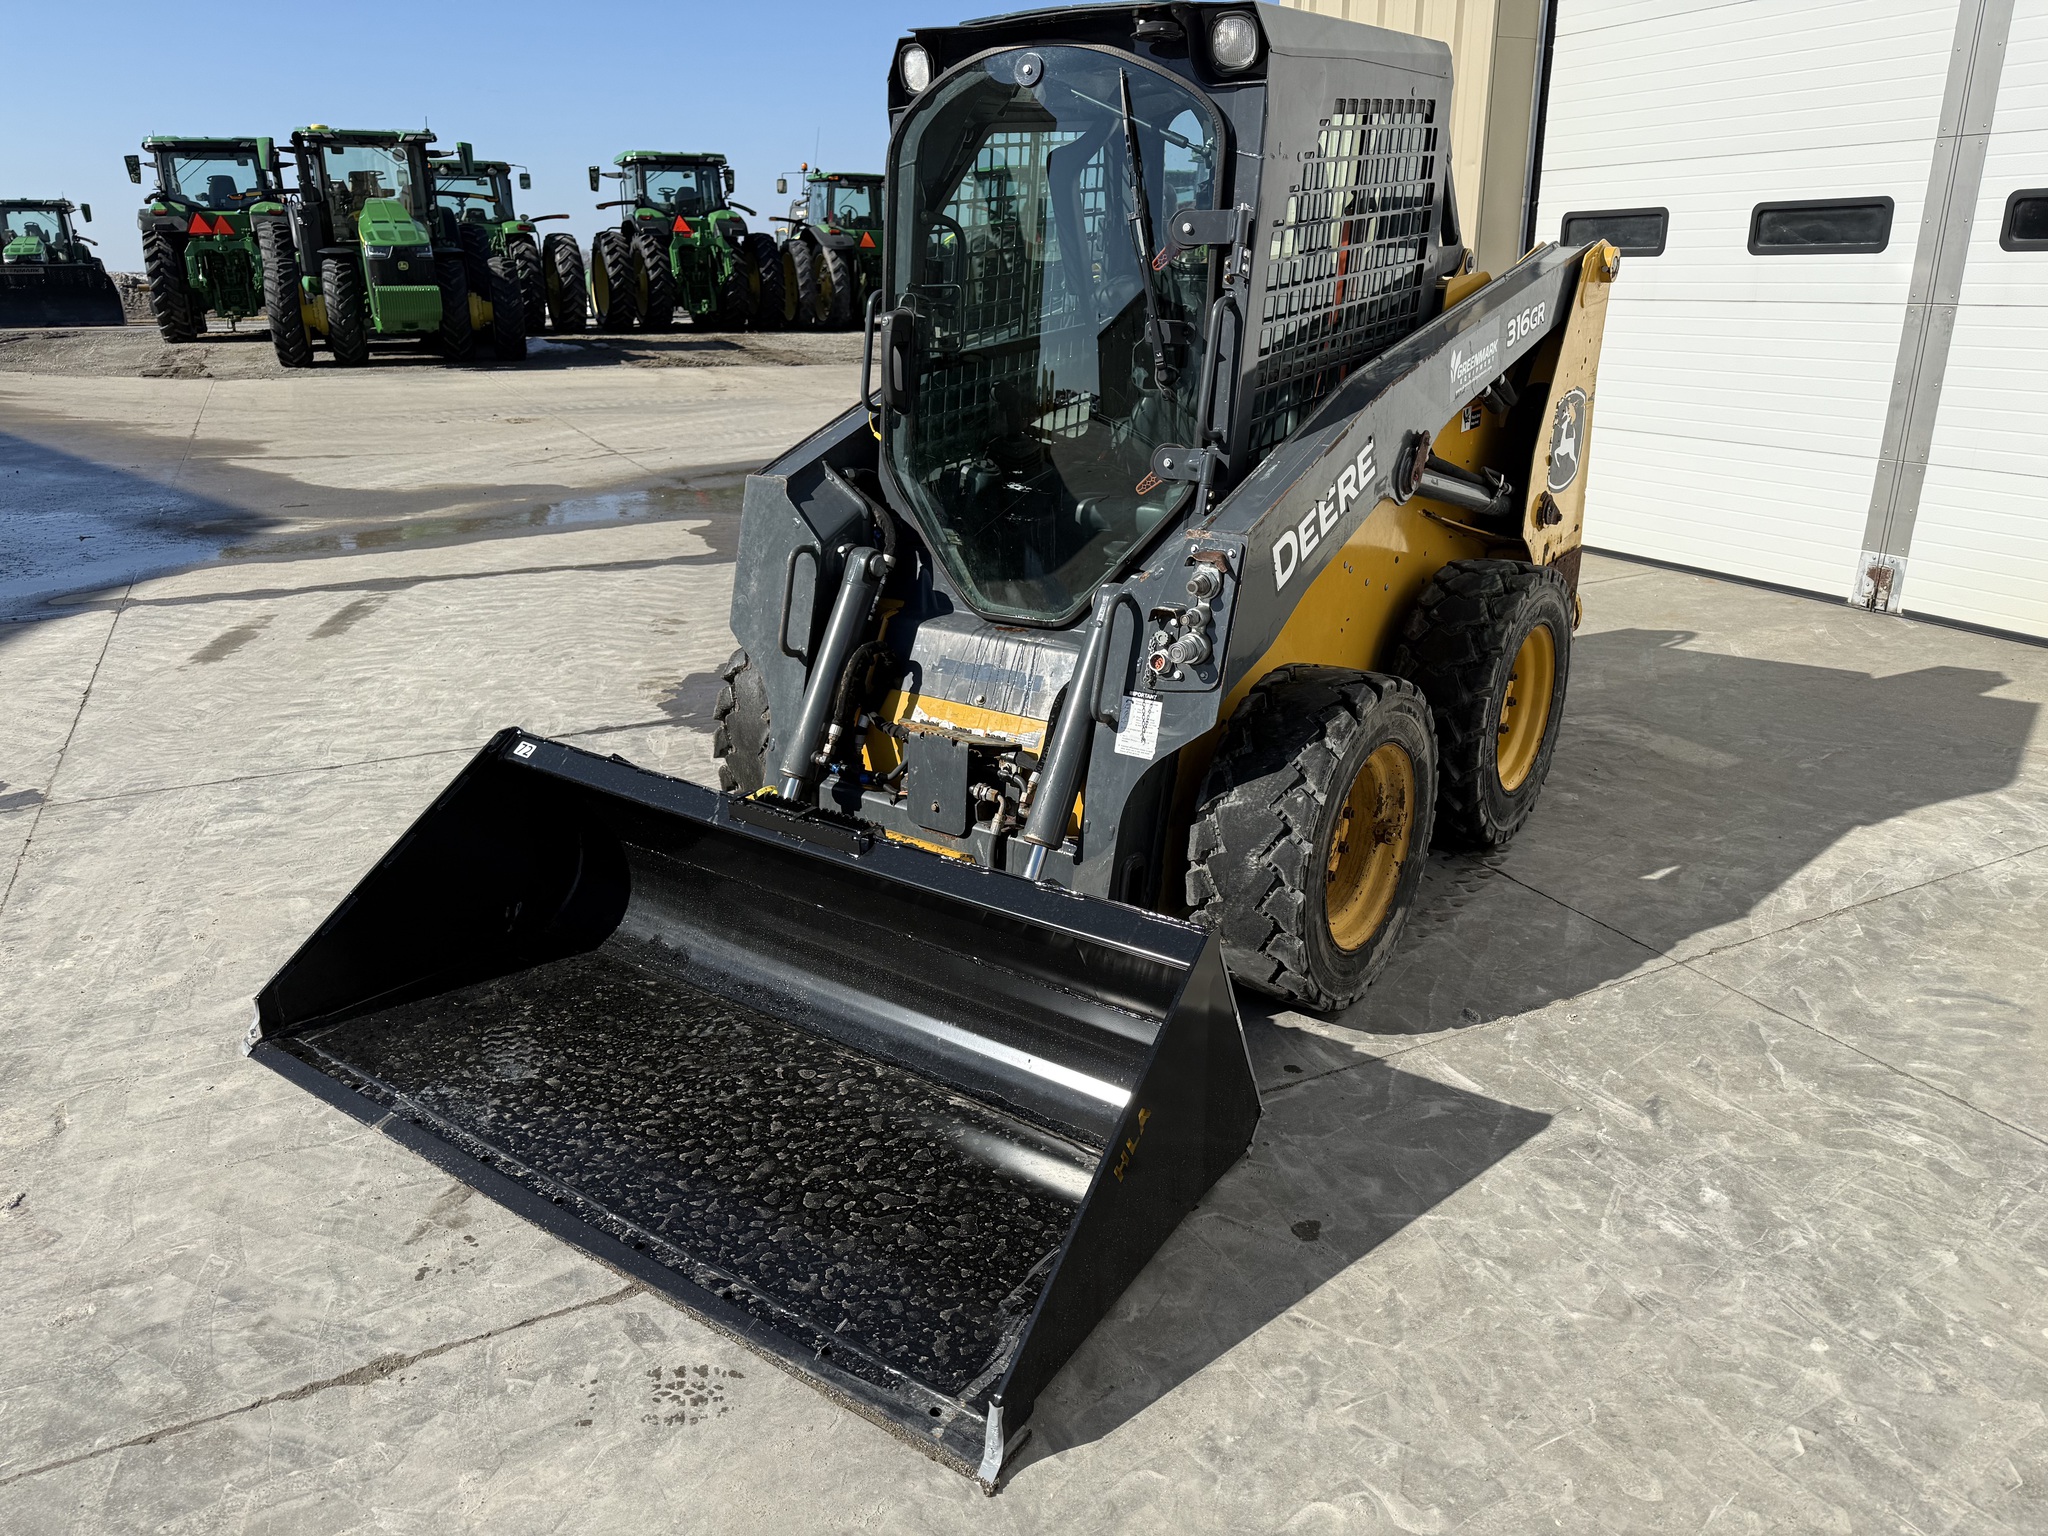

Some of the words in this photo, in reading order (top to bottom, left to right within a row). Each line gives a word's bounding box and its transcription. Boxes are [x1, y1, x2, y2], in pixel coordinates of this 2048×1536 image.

[1506, 302, 1546, 348] 316GR
[1457, 339, 1498, 379] GREENMARK
[1272, 437, 1376, 592] DEERE
[516, 743, 534, 757] 72
